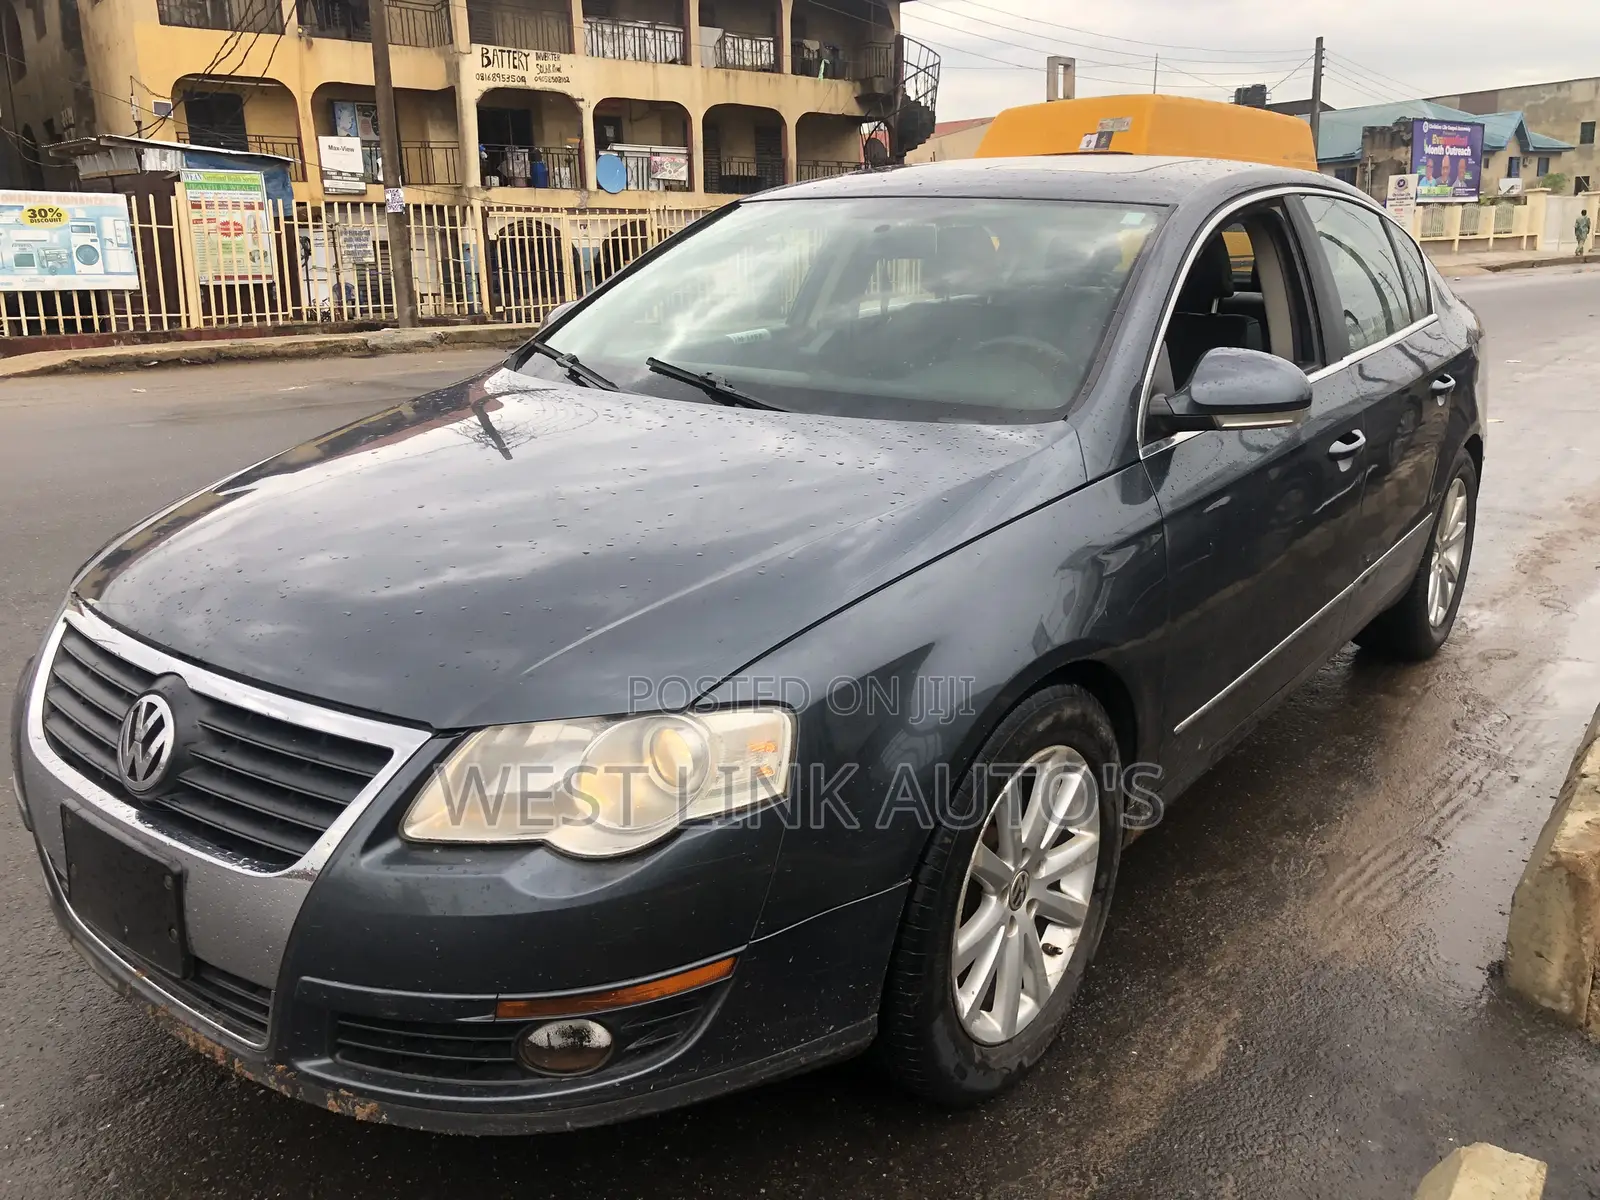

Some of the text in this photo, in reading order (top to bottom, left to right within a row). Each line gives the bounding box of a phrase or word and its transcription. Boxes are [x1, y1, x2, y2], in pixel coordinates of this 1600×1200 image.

[481, 47, 561, 71] BATTERY INVERTER
[1424, 144, 1471, 156] Month Outreach
[27, 207, 62, 218] 30%
